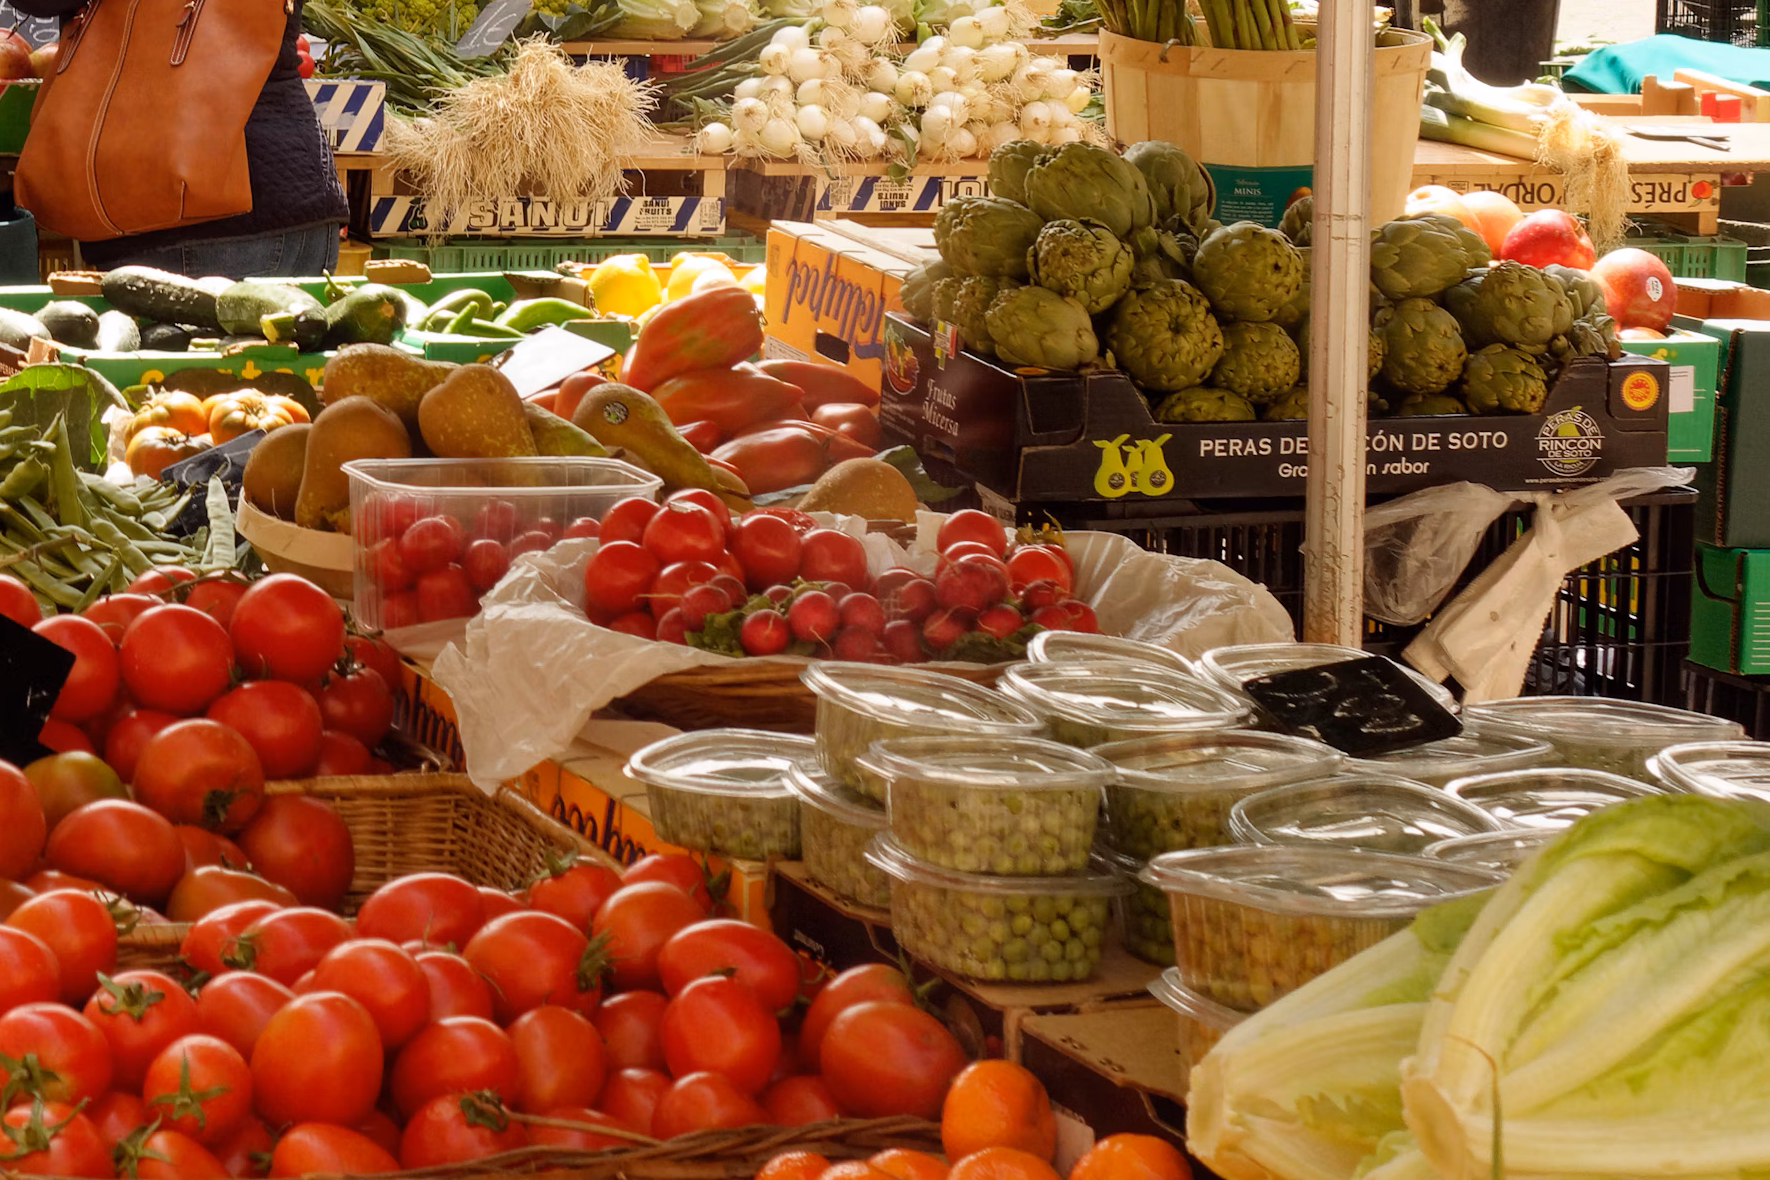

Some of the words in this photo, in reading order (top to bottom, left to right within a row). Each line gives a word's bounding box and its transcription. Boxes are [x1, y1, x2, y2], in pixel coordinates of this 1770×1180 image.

[877, 192, 909, 200] FRUITS
[1233, 187, 1262, 196] MINIS
[1631, 181, 1688, 210] PRÉS
[642, 199, 670, 208] SANUI
[879, 200, 907, 209] SANUI
[468, 200, 610, 228] SANUI
[927, 378, 957, 411] Frutas
[1542, 412, 1583, 437] PERAS
[1581, 417, 1598, 436] DE
[1199, 437, 1272, 457] PERAS
[1411, 432, 1441, 451] DE
[1447, 431, 1508, 450] SOTO
[1547, 450, 1562, 458] DE
[1563, 449, 1592, 458] SOTO
[1381, 457, 1430, 475] sabor
